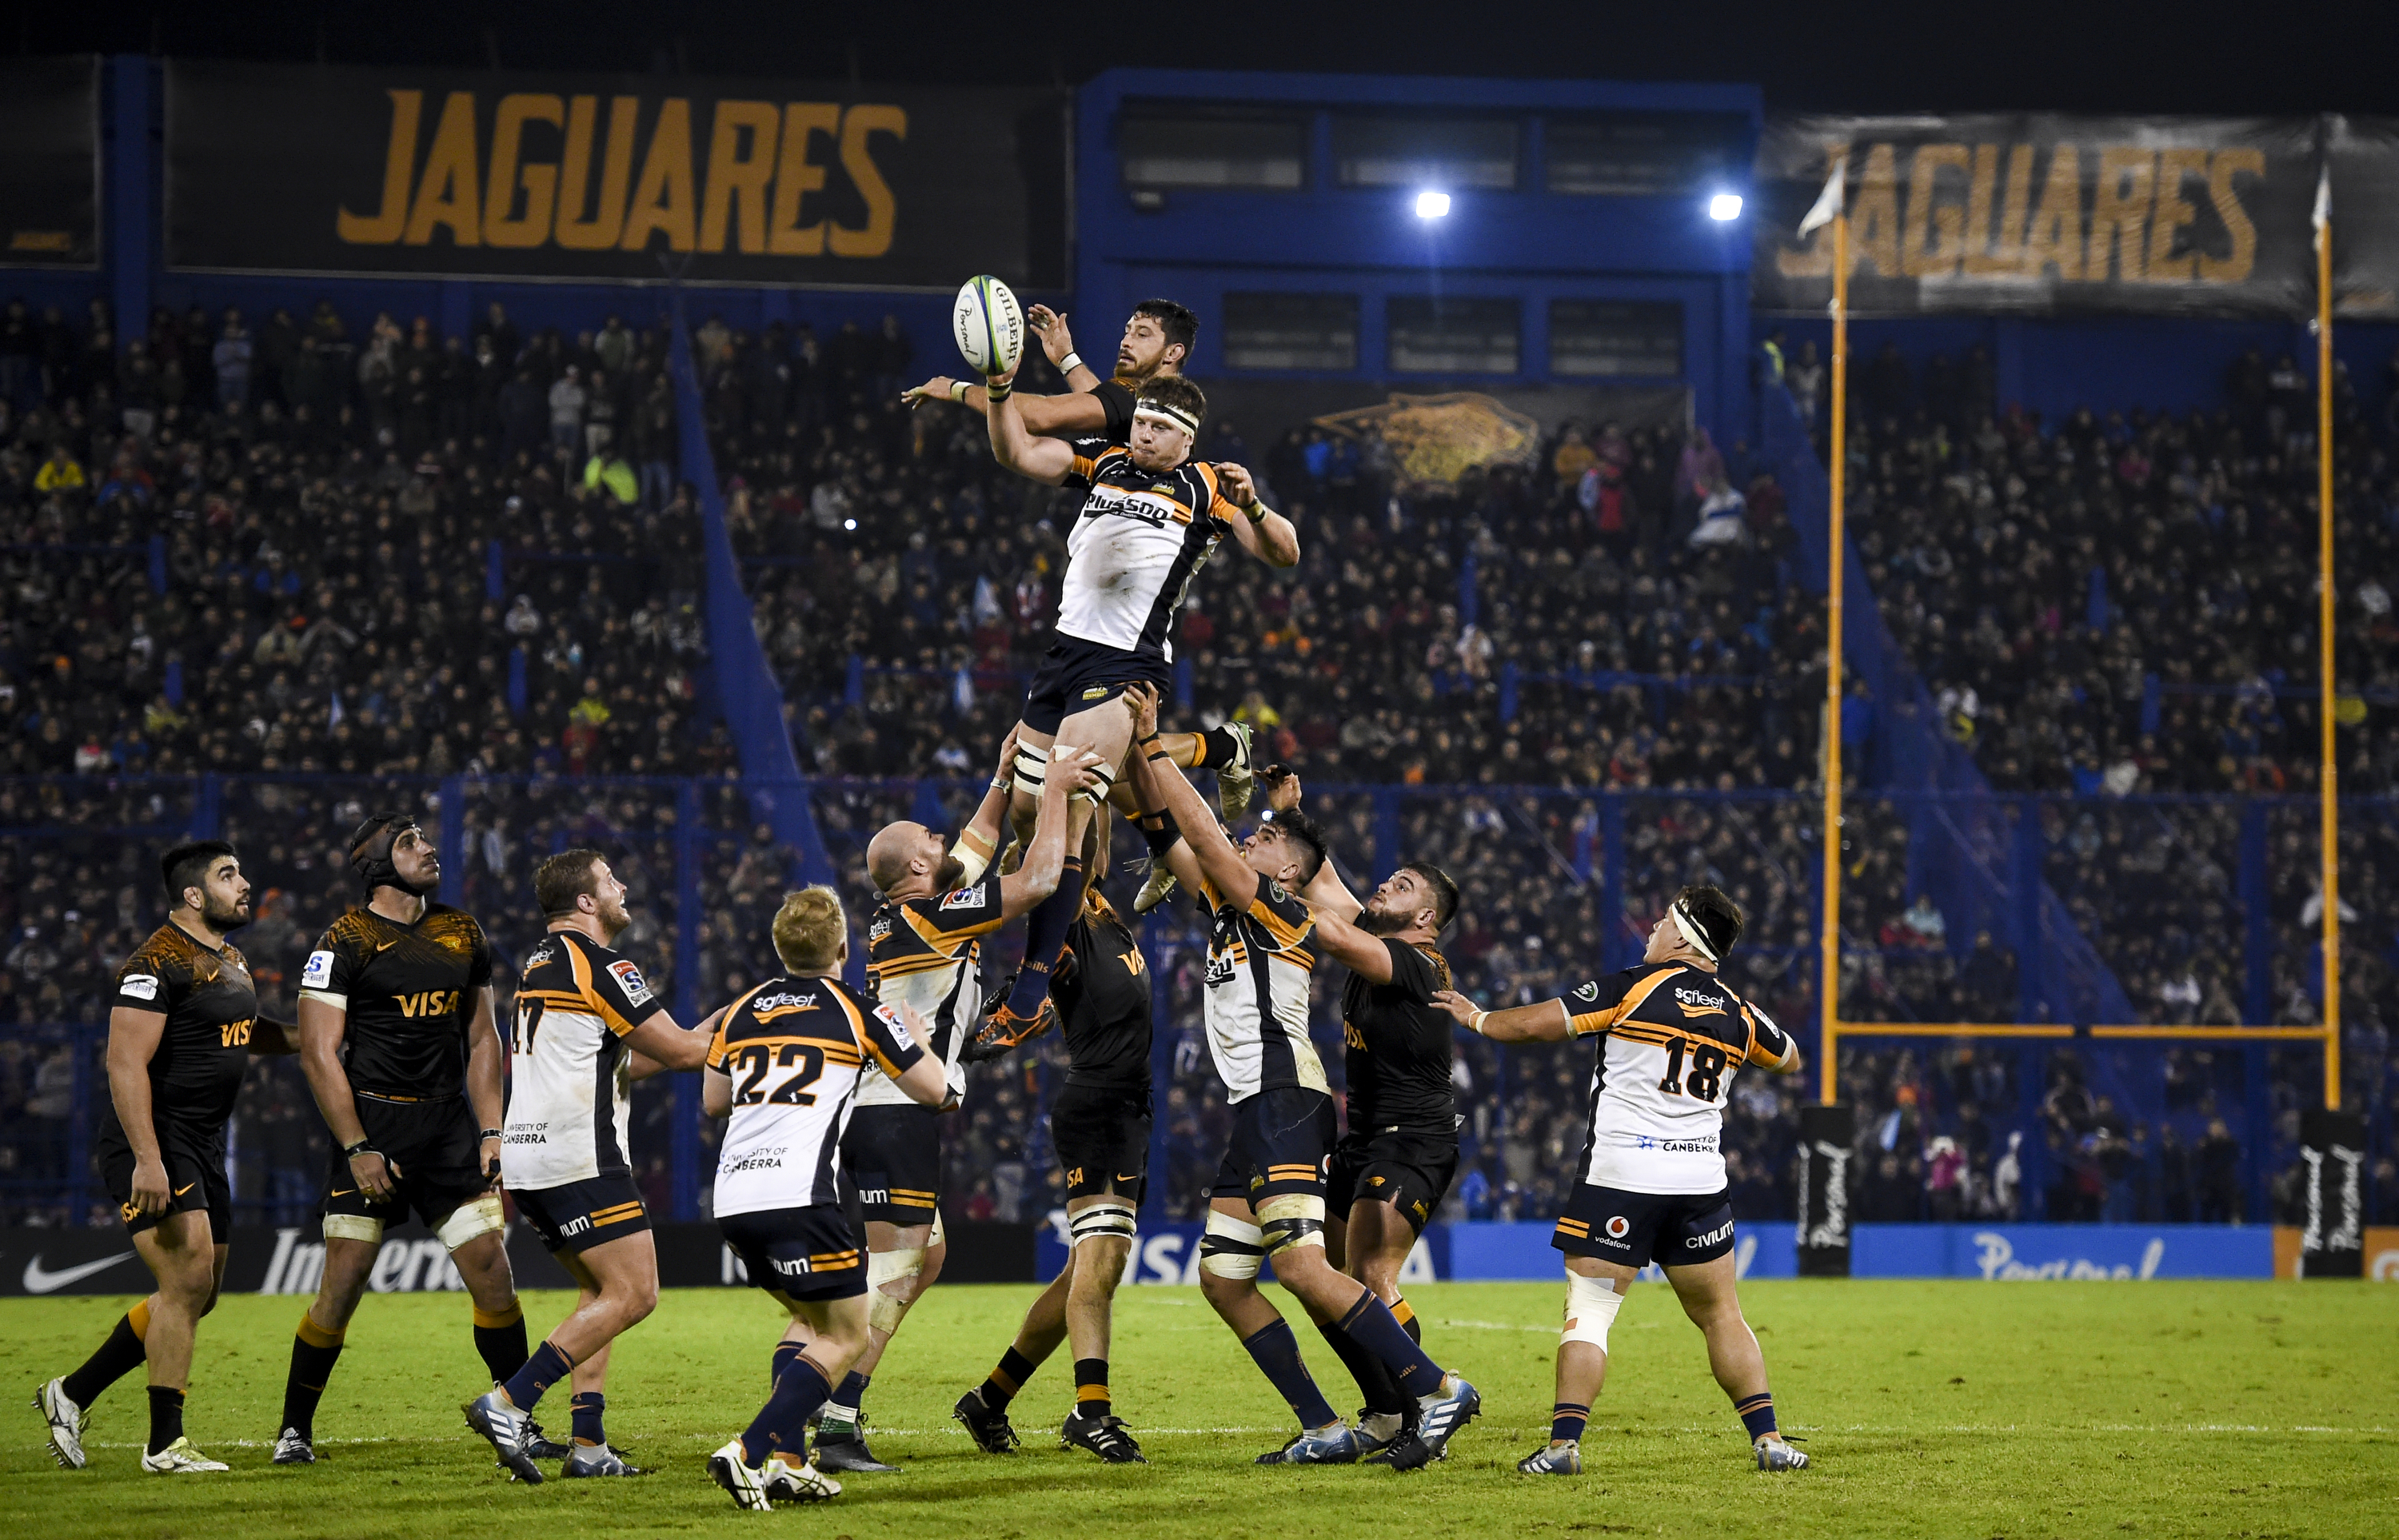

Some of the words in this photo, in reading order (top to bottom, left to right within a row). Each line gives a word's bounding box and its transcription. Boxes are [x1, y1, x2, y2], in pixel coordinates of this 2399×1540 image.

[337, 89, 907, 257] JAGUARES
[959, 307, 979, 356] Personal
[996, 286, 1019, 361] GILBERT
[391, 990, 460, 1018] VISA
[753, 993, 816, 1011] sgfleet
[1675, 987, 1725, 1011] sgfleet
[218, 1019, 255, 1047] VIS
[734, 1043, 824, 1108] 22
[1658, 1035, 1727, 1103] 18
[503, 1133, 547, 1144] CANBERRA
[536, 1122, 549, 1131] OF
[773, 1147, 788, 1156] OF
[1595, 1235, 1631, 1251] vodafone
